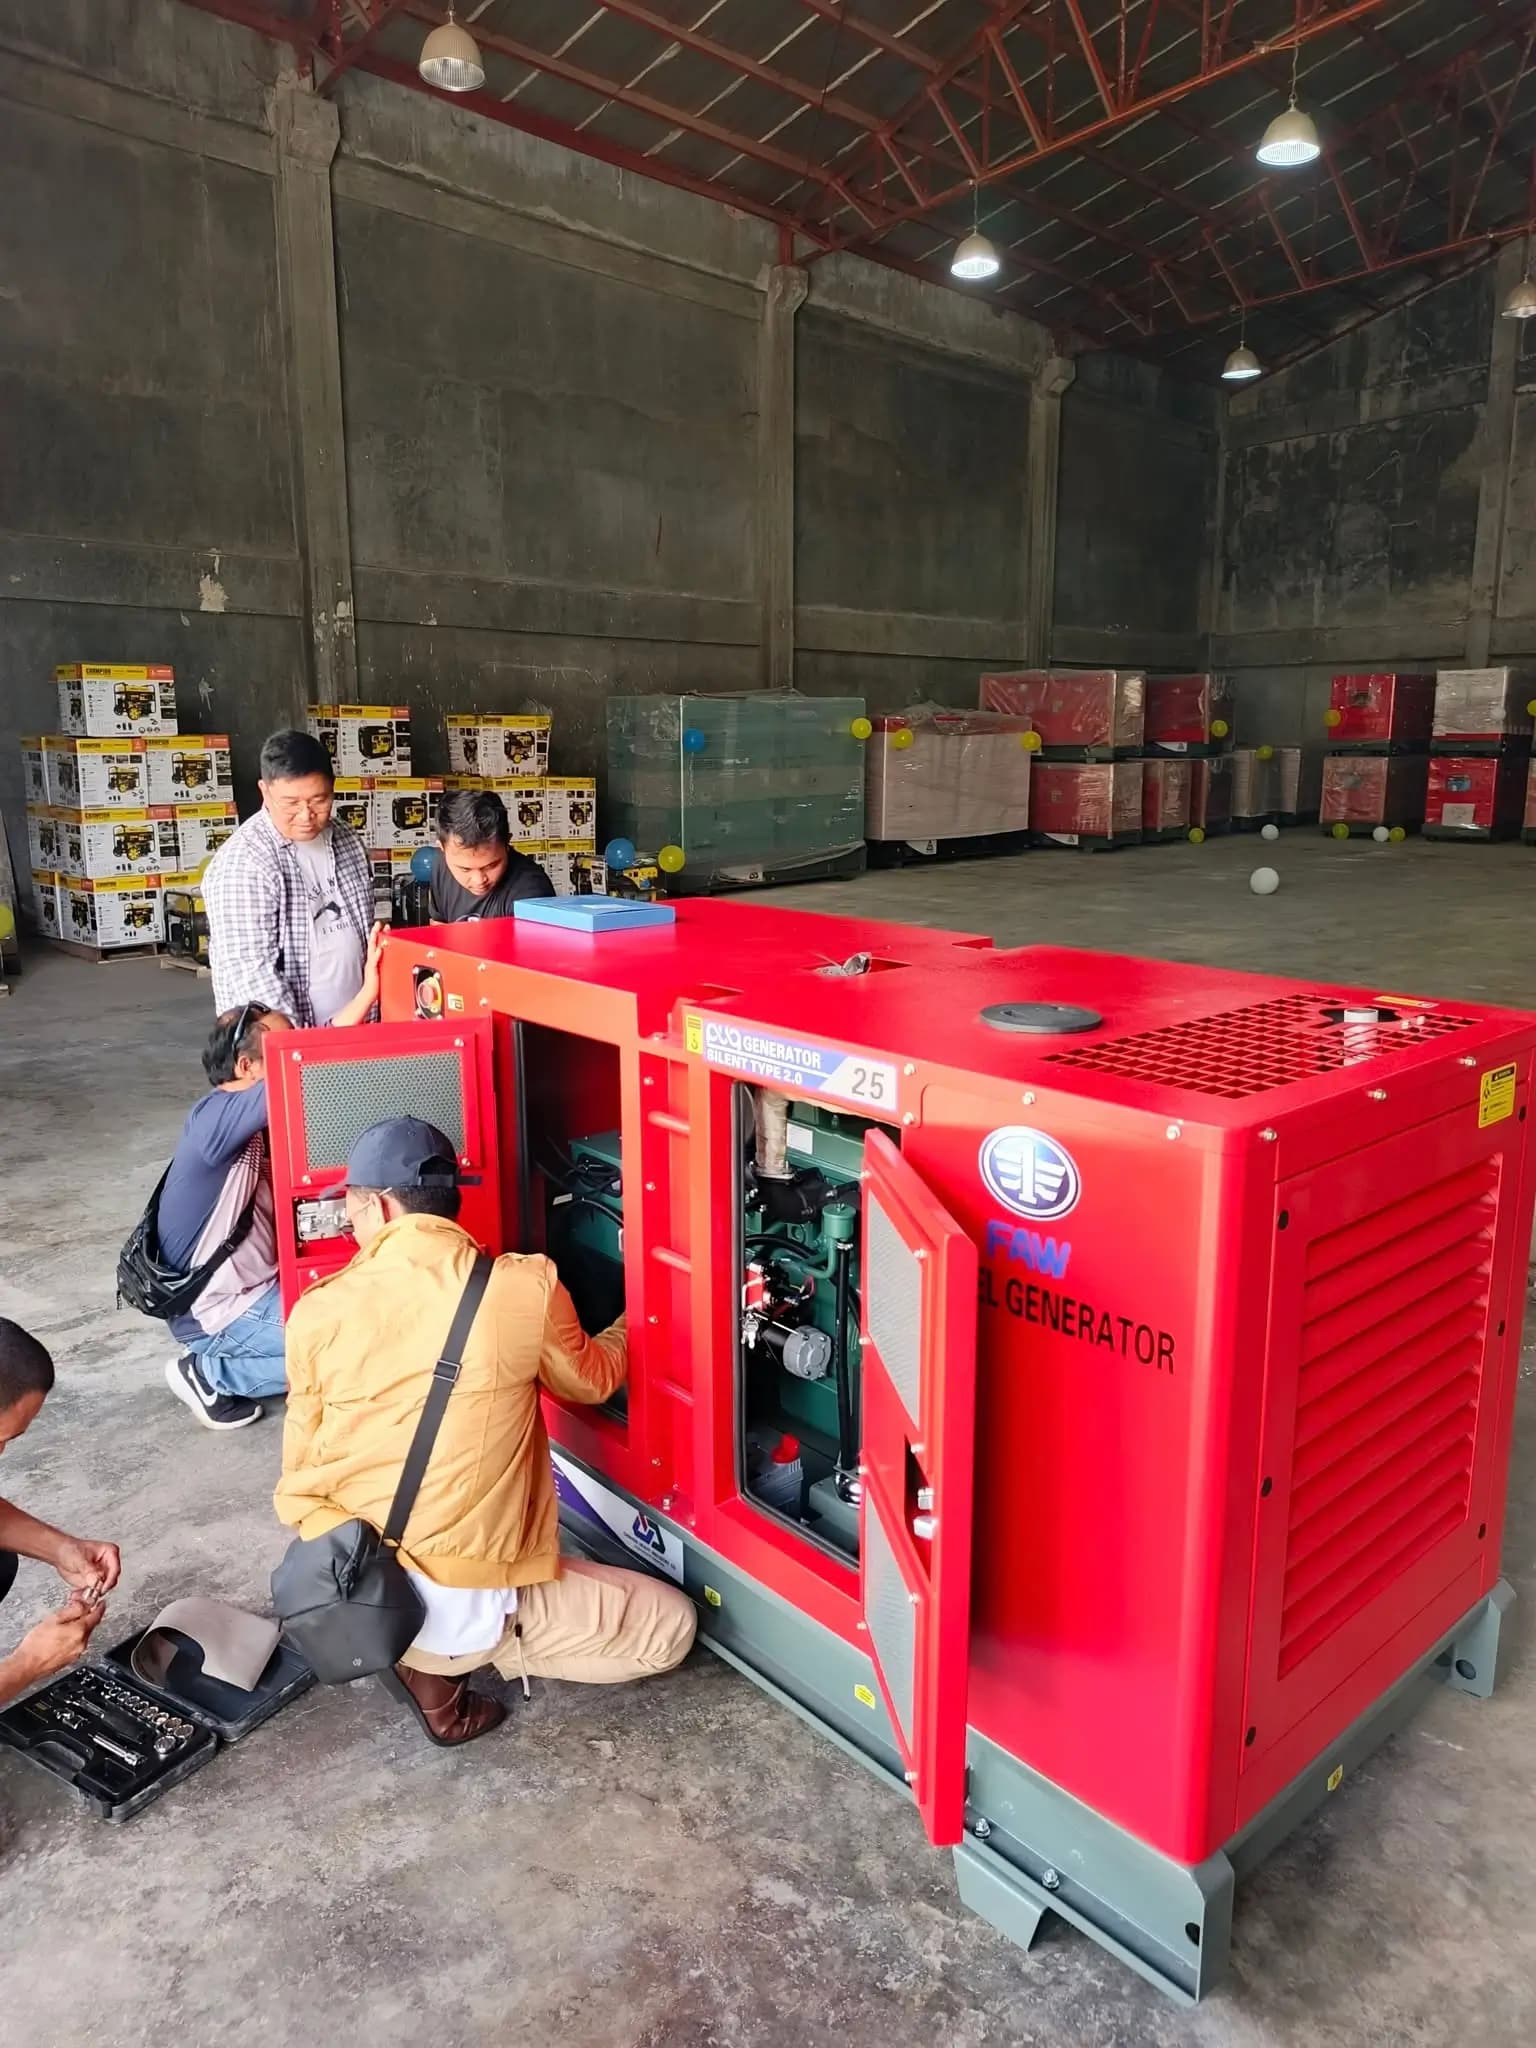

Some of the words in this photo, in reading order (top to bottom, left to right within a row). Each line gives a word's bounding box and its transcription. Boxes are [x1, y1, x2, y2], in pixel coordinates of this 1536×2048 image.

[707, 1048, 748, 1070] SILENT
[750, 1060, 783, 1080] TYPE
[784, 1071, 803, 1086] 2.0
[743, 1035, 821, 1069] GENERATOR
[852, 1067, 885, 1099] 25
[987, 1219, 1072, 1280] FAW
[1006, 1278, 1175, 1375] GENERATOR
